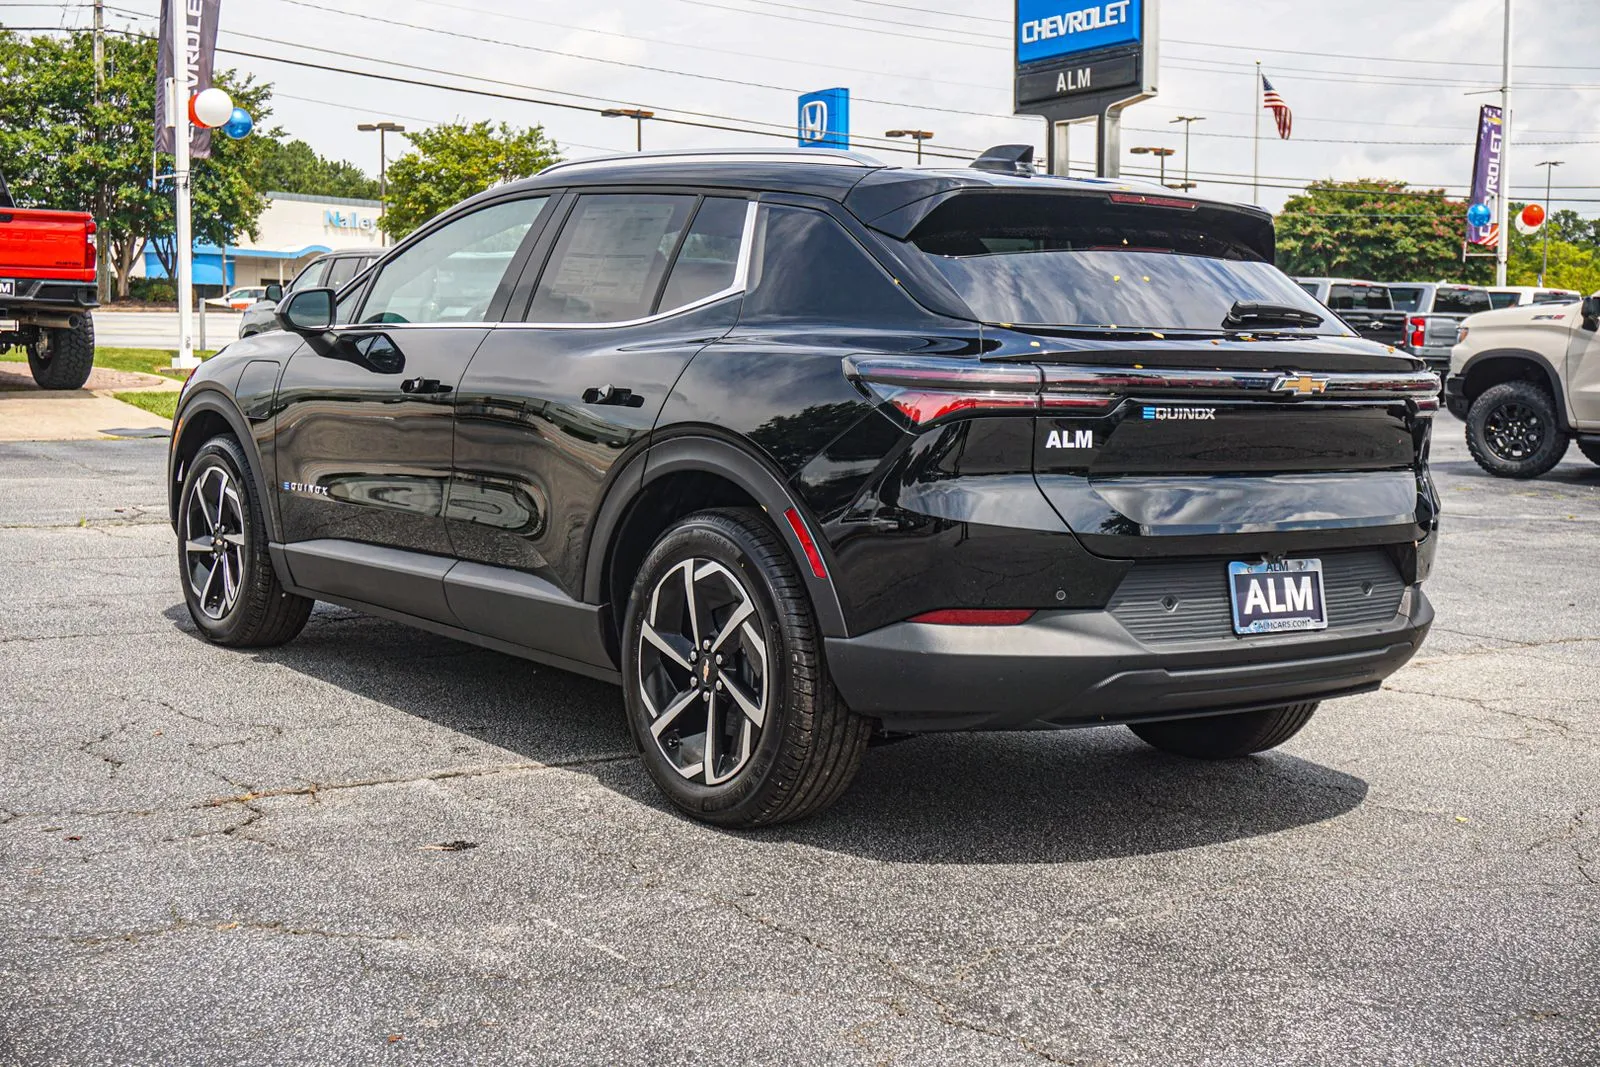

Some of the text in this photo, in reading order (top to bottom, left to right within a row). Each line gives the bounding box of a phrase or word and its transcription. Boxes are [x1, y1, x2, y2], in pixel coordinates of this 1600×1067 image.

[1021, 0, 1130, 45] CHEVROLET
[1056, 67, 1091, 93] ALM
[1142, 406, 1217, 421] EQUINOX
[1045, 430, 1093, 449] ALM
[283, 481, 329, 497] EQUINOX
[1266, 560, 1289, 572] ALM
[1243, 575, 1315, 616] ALM
[1258, 619, 1308, 631] ALMCARS.COM
